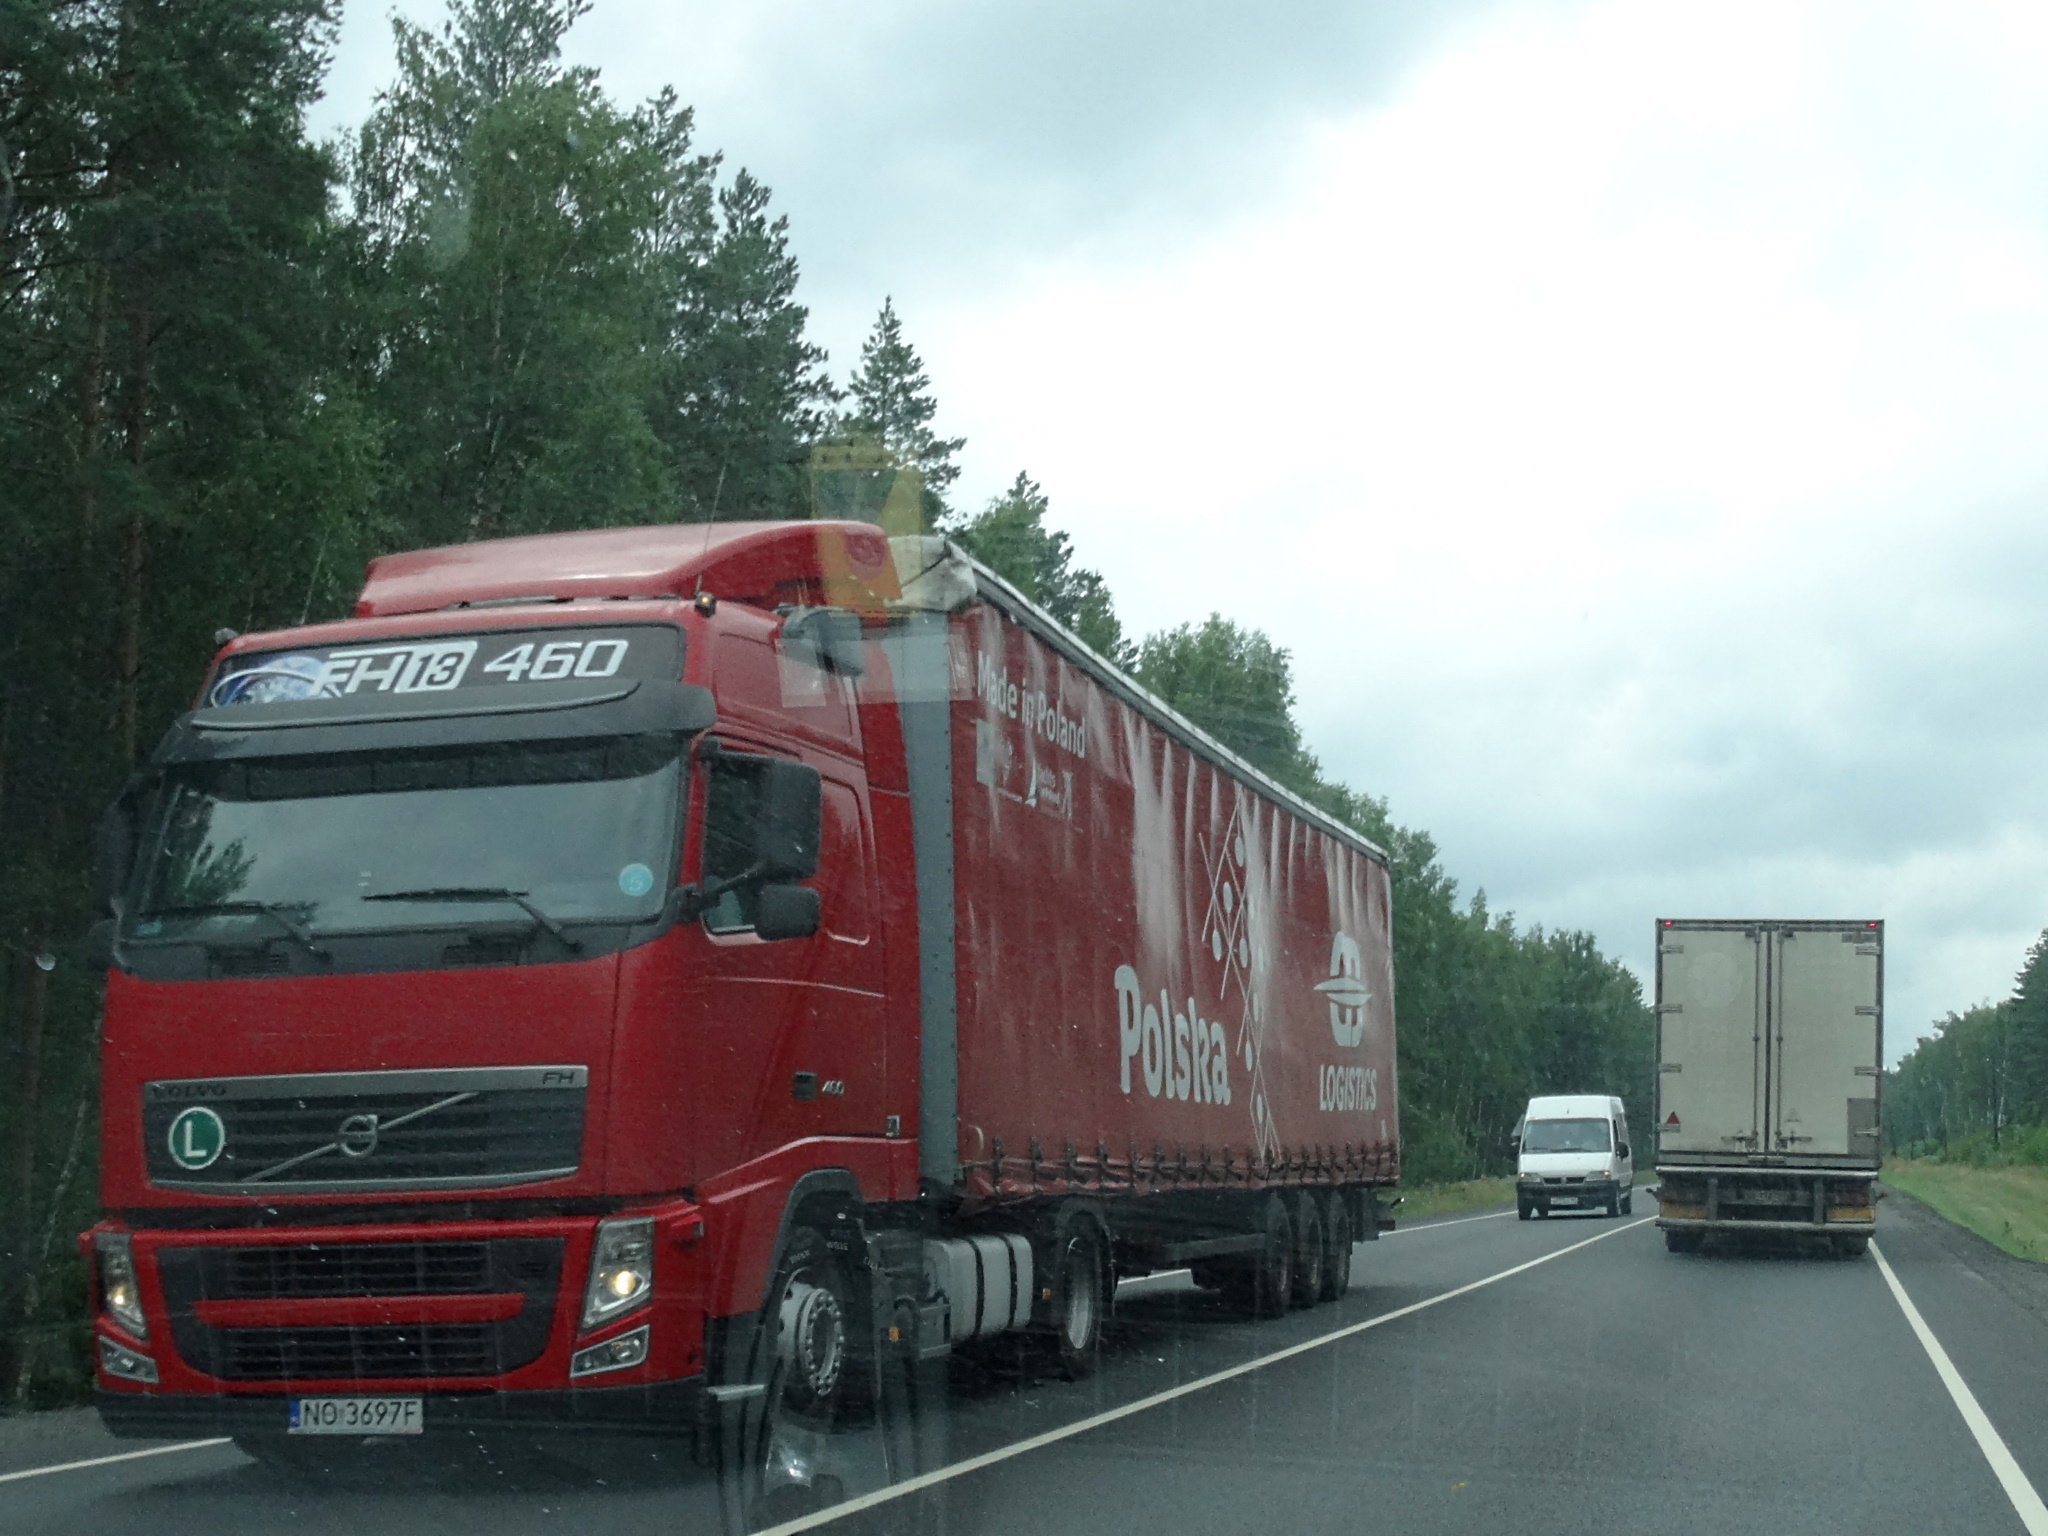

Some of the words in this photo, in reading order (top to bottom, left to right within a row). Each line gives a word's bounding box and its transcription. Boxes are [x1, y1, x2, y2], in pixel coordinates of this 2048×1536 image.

[484, 640, 629, 682] 460
[977, 649, 1018, 719] Made
[1021, 678, 1034, 729] in
[1037, 690, 1086, 759] Poland
[1114, 964, 1231, 1106] Polska
[542, 1072, 576, 1085] FH
[1319, 1064, 1378, 1112] LOGISTICS
[184, 1120, 207, 1158] L
[303, 1402, 338, 1426] NO
[346, 1401, 417, 1426] 3697F
